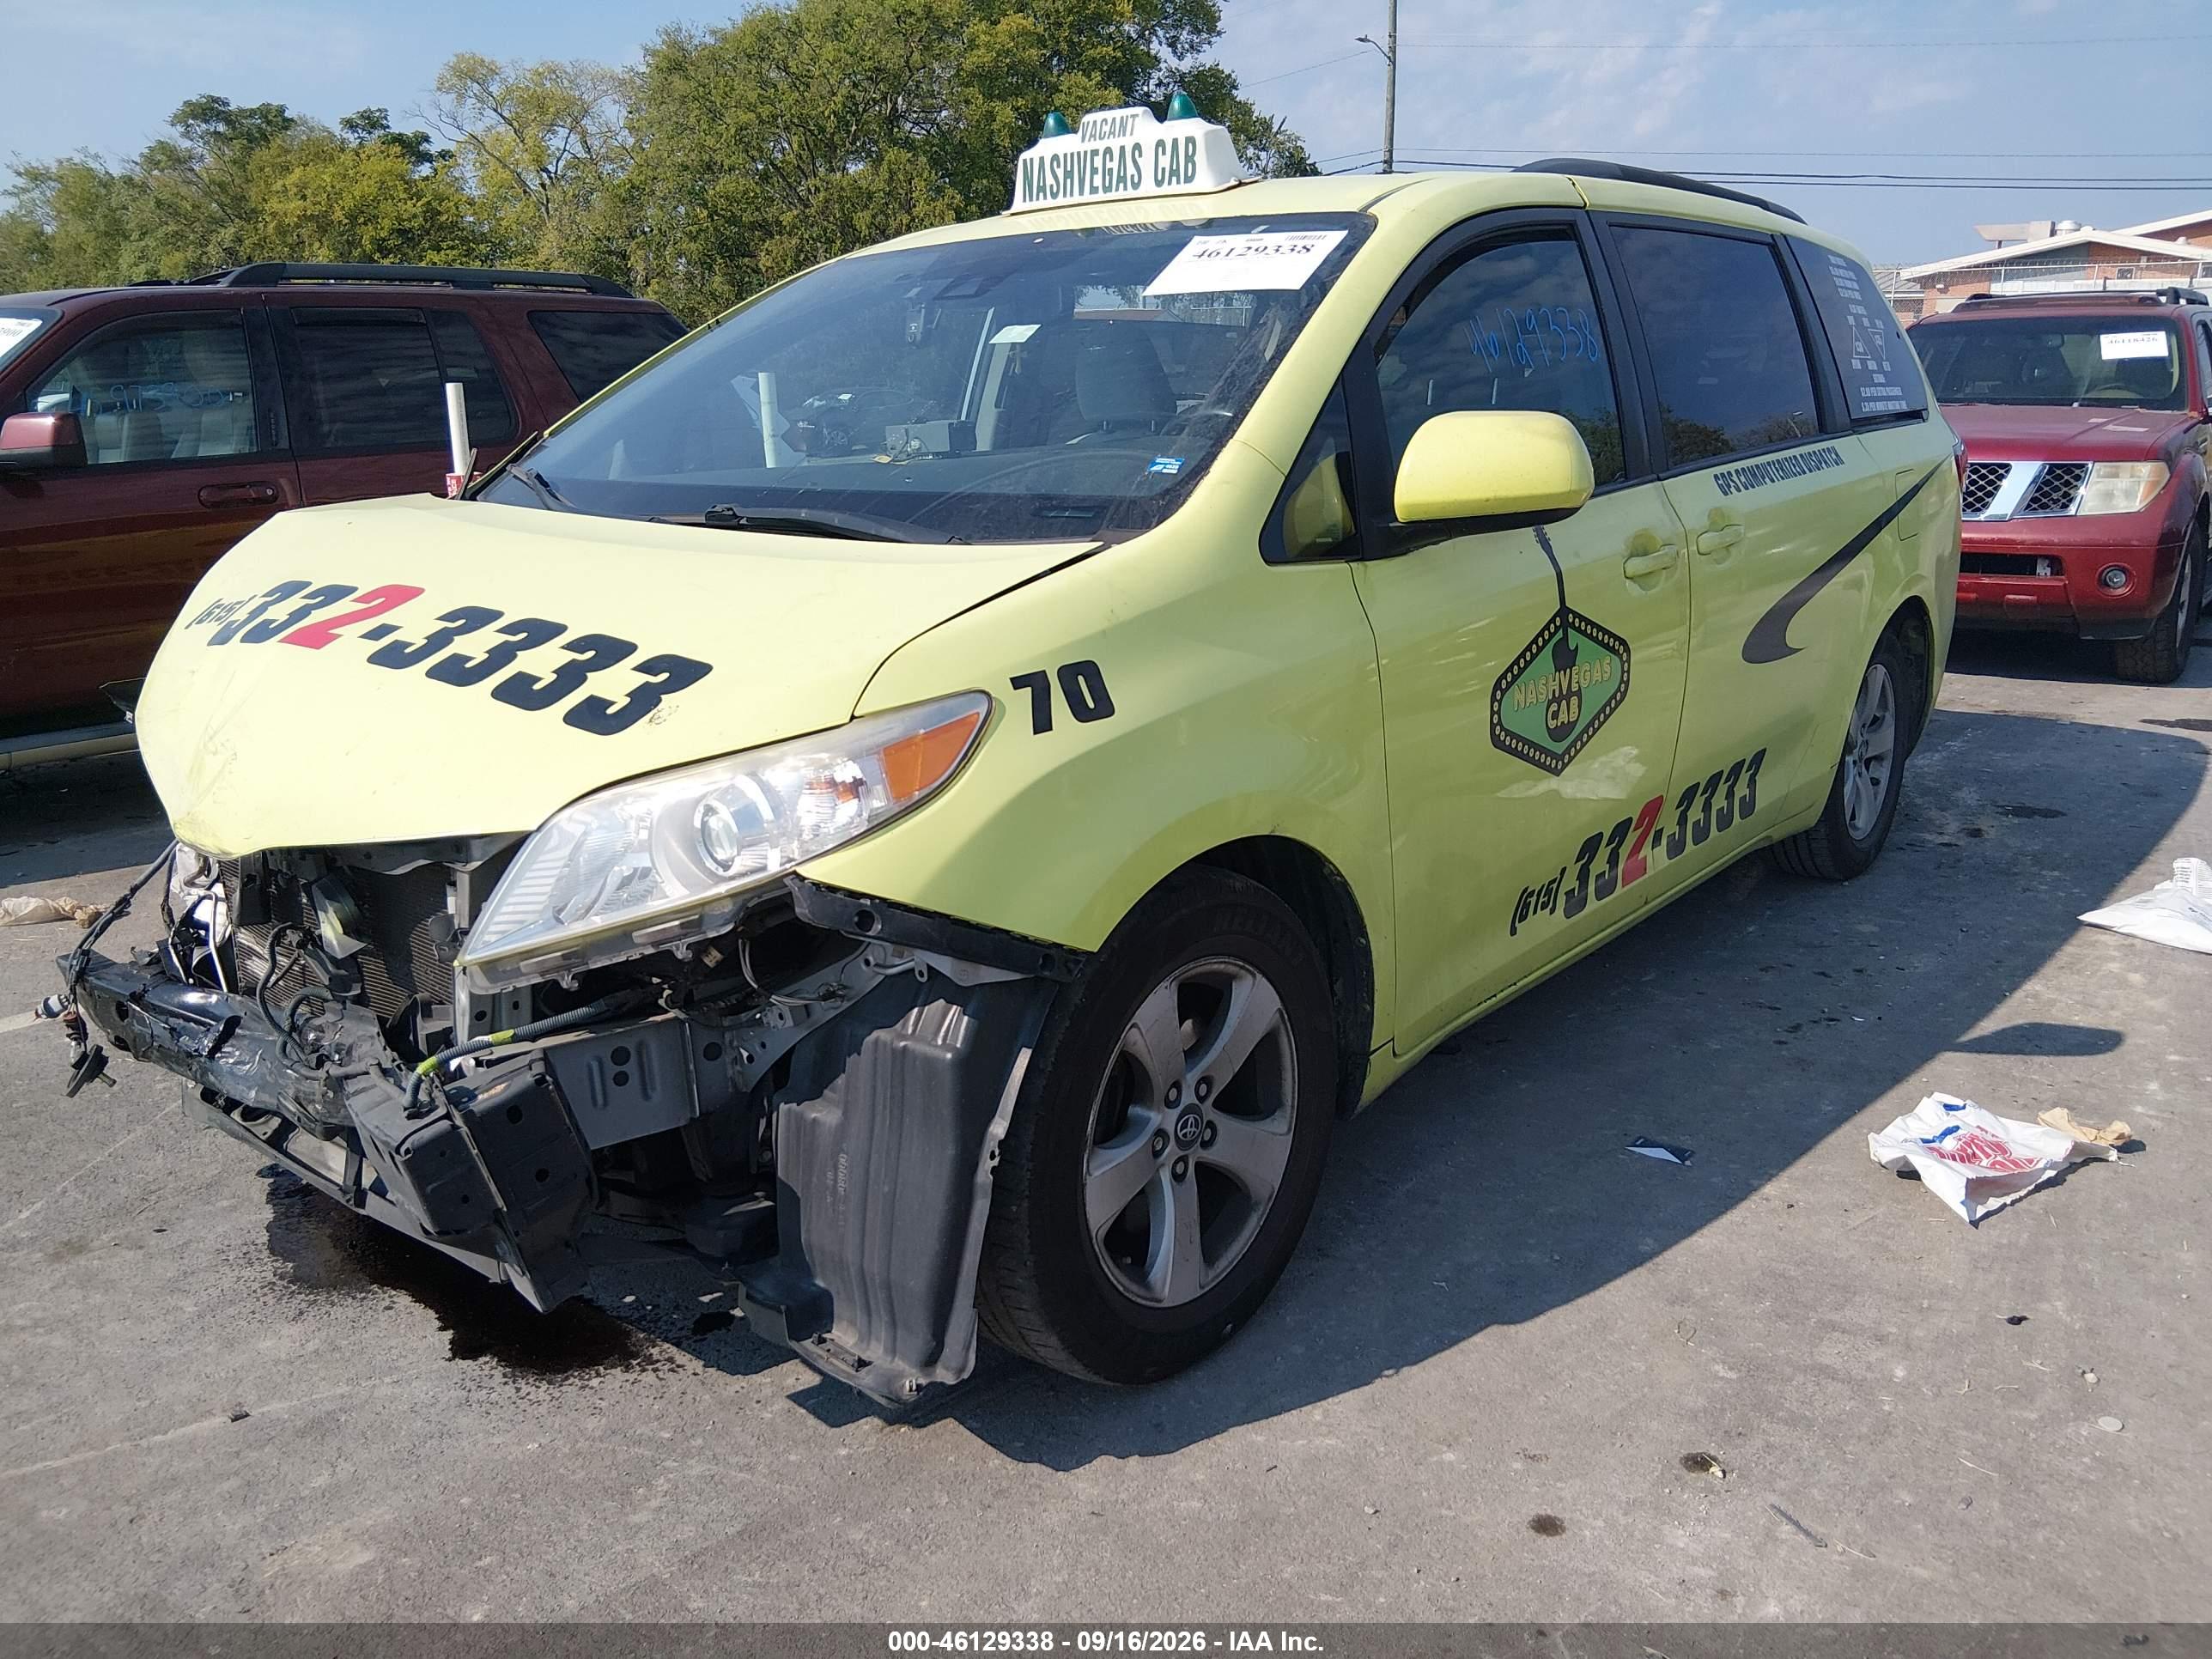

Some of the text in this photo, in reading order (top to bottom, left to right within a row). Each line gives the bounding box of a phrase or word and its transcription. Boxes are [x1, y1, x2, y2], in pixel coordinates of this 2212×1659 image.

[1081, 113, 1140, 144] VACANT
[1022, 135, 1198, 204] NASHVEGAS CAB
[1192, 243, 1316, 259] 46129338
[1713, 446, 1845, 496] GPS COMPUTERIZED DISPATCH
[1009, 659, 1115, 736] 70
[1514, 655, 1612, 712] NASHVEGAS
[1547, 696, 1580, 729] CAB
